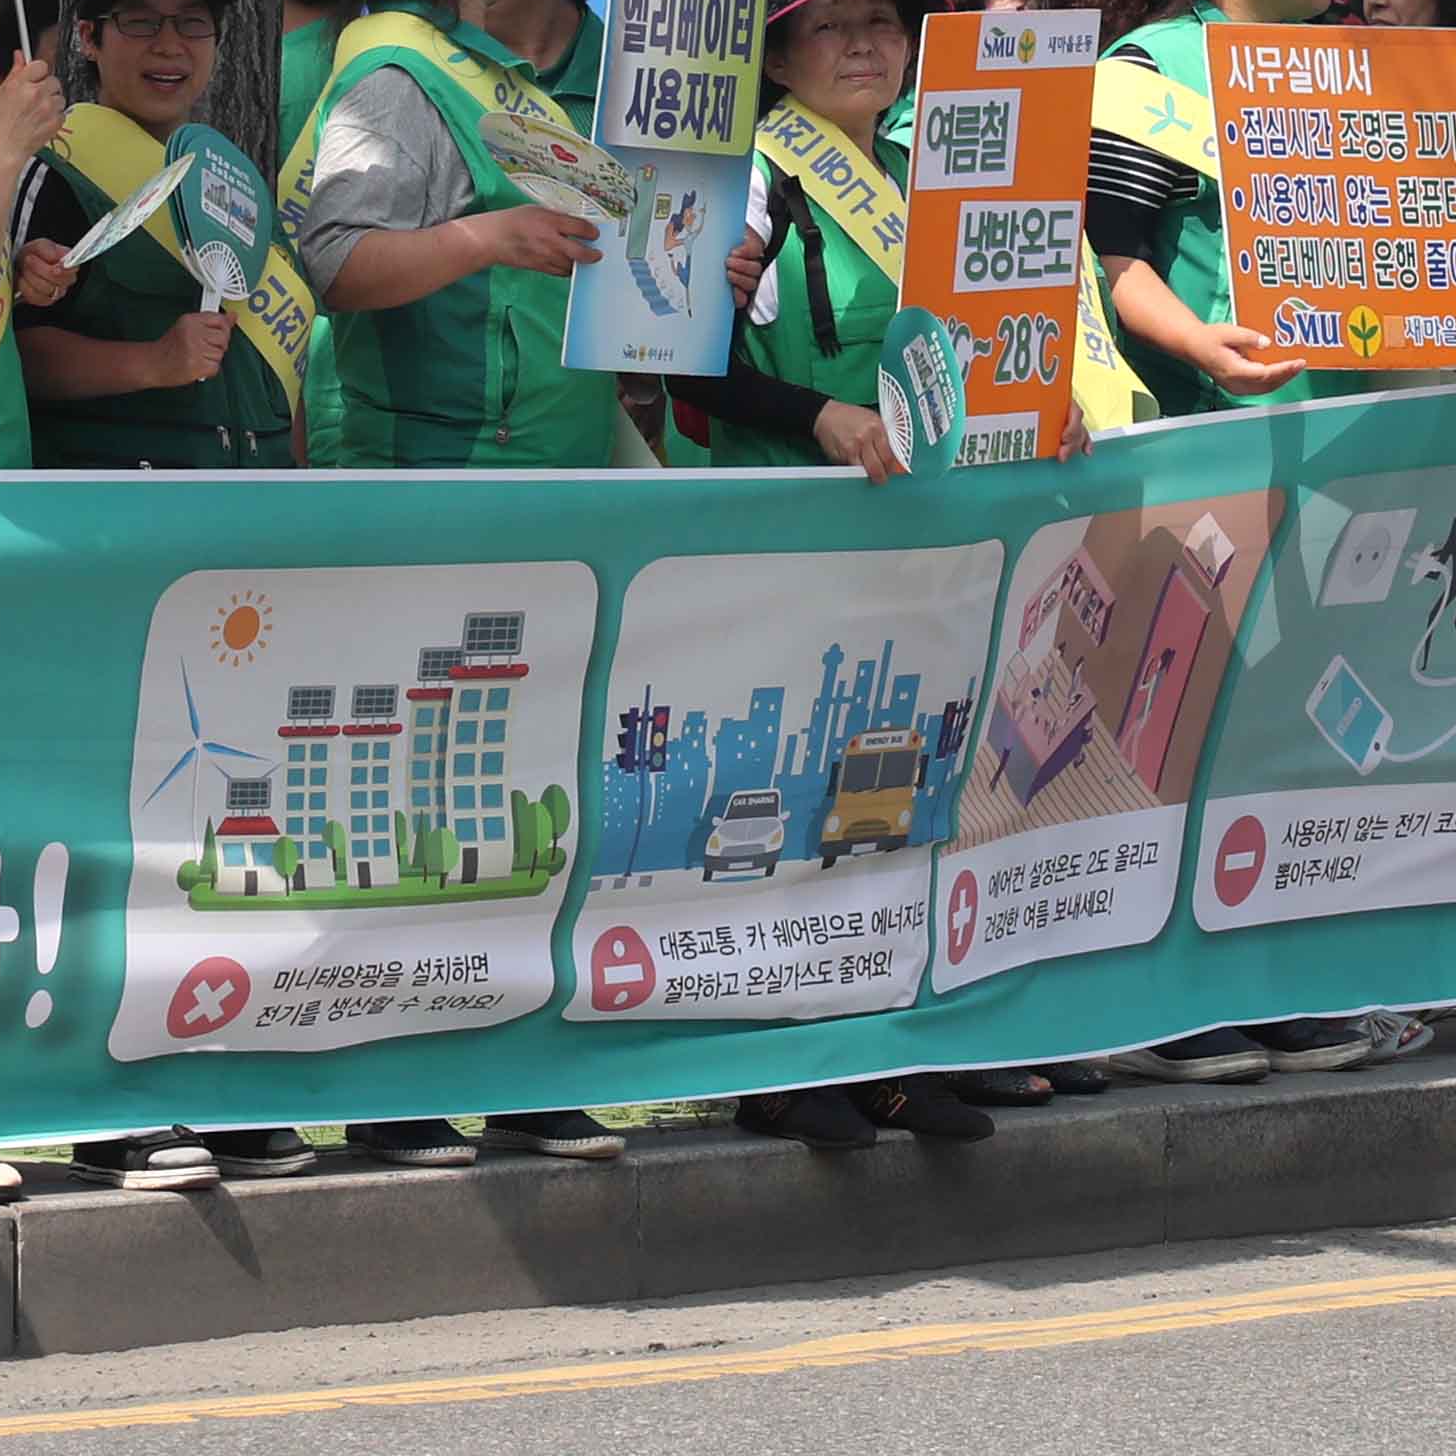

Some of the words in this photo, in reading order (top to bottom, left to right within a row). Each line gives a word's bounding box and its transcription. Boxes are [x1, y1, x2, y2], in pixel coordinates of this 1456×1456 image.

[983, 28, 1016, 60] SMU
[1047, 31, 1094, 55] 새마을운동
[1227, 44, 1373, 96] 사무실에서
[624, 66, 738, 143] 사용자제
[925, 100, 1010, 177] 여름철
[1242, 107, 1334, 160] 점심시간
[1338, 110, 1410, 162] 조명등
[1250, 173, 1339, 227] 사용하지
[1344, 175, 1391, 228] 않는
[962, 206, 1075, 285] 냉방온도
[1254, 235, 1368, 290] 엘리베이터
[1371, 238, 1420, 290] 운행
[247, 275, 310, 356] 인천
[1274, 297, 1344, 348] SMU
[1281, 815, 1351, 848] 사용하지
[1354, 815, 1389, 843] 않는
[1393, 811, 1433, 839] 전기
[988, 865, 1026, 899] 에어컨
[1028, 852, 1084, 890] 설정온도
[1085, 849, 1112, 876] 2도
[1114, 840, 1160, 870] 올리고
[1273, 855, 1361, 891] 뽑아주세요!
[658, 924, 743, 962] 대중교통,
[746, 922, 767, 951] 카
[771, 910, 865, 948] 쉐어링으로
[983, 908, 1019, 944] 건강한
[1021, 902, 1050, 930] 여름
[1052, 887, 1115, 924] 보내세요!
[272, 960, 405, 994] 미니태양광을
[410, 952, 491, 987] 설치하면
[663, 972, 740, 1006] 절약하고
[745, 958, 834, 997] 온실가스도
[838, 948, 895, 986] 줄여요!
[254, 998, 323, 1029] 전기를
[326, 994, 394, 1022] 생산할
[396, 994, 422, 1014] 수
[423, 991, 506, 1014] 있어요!
